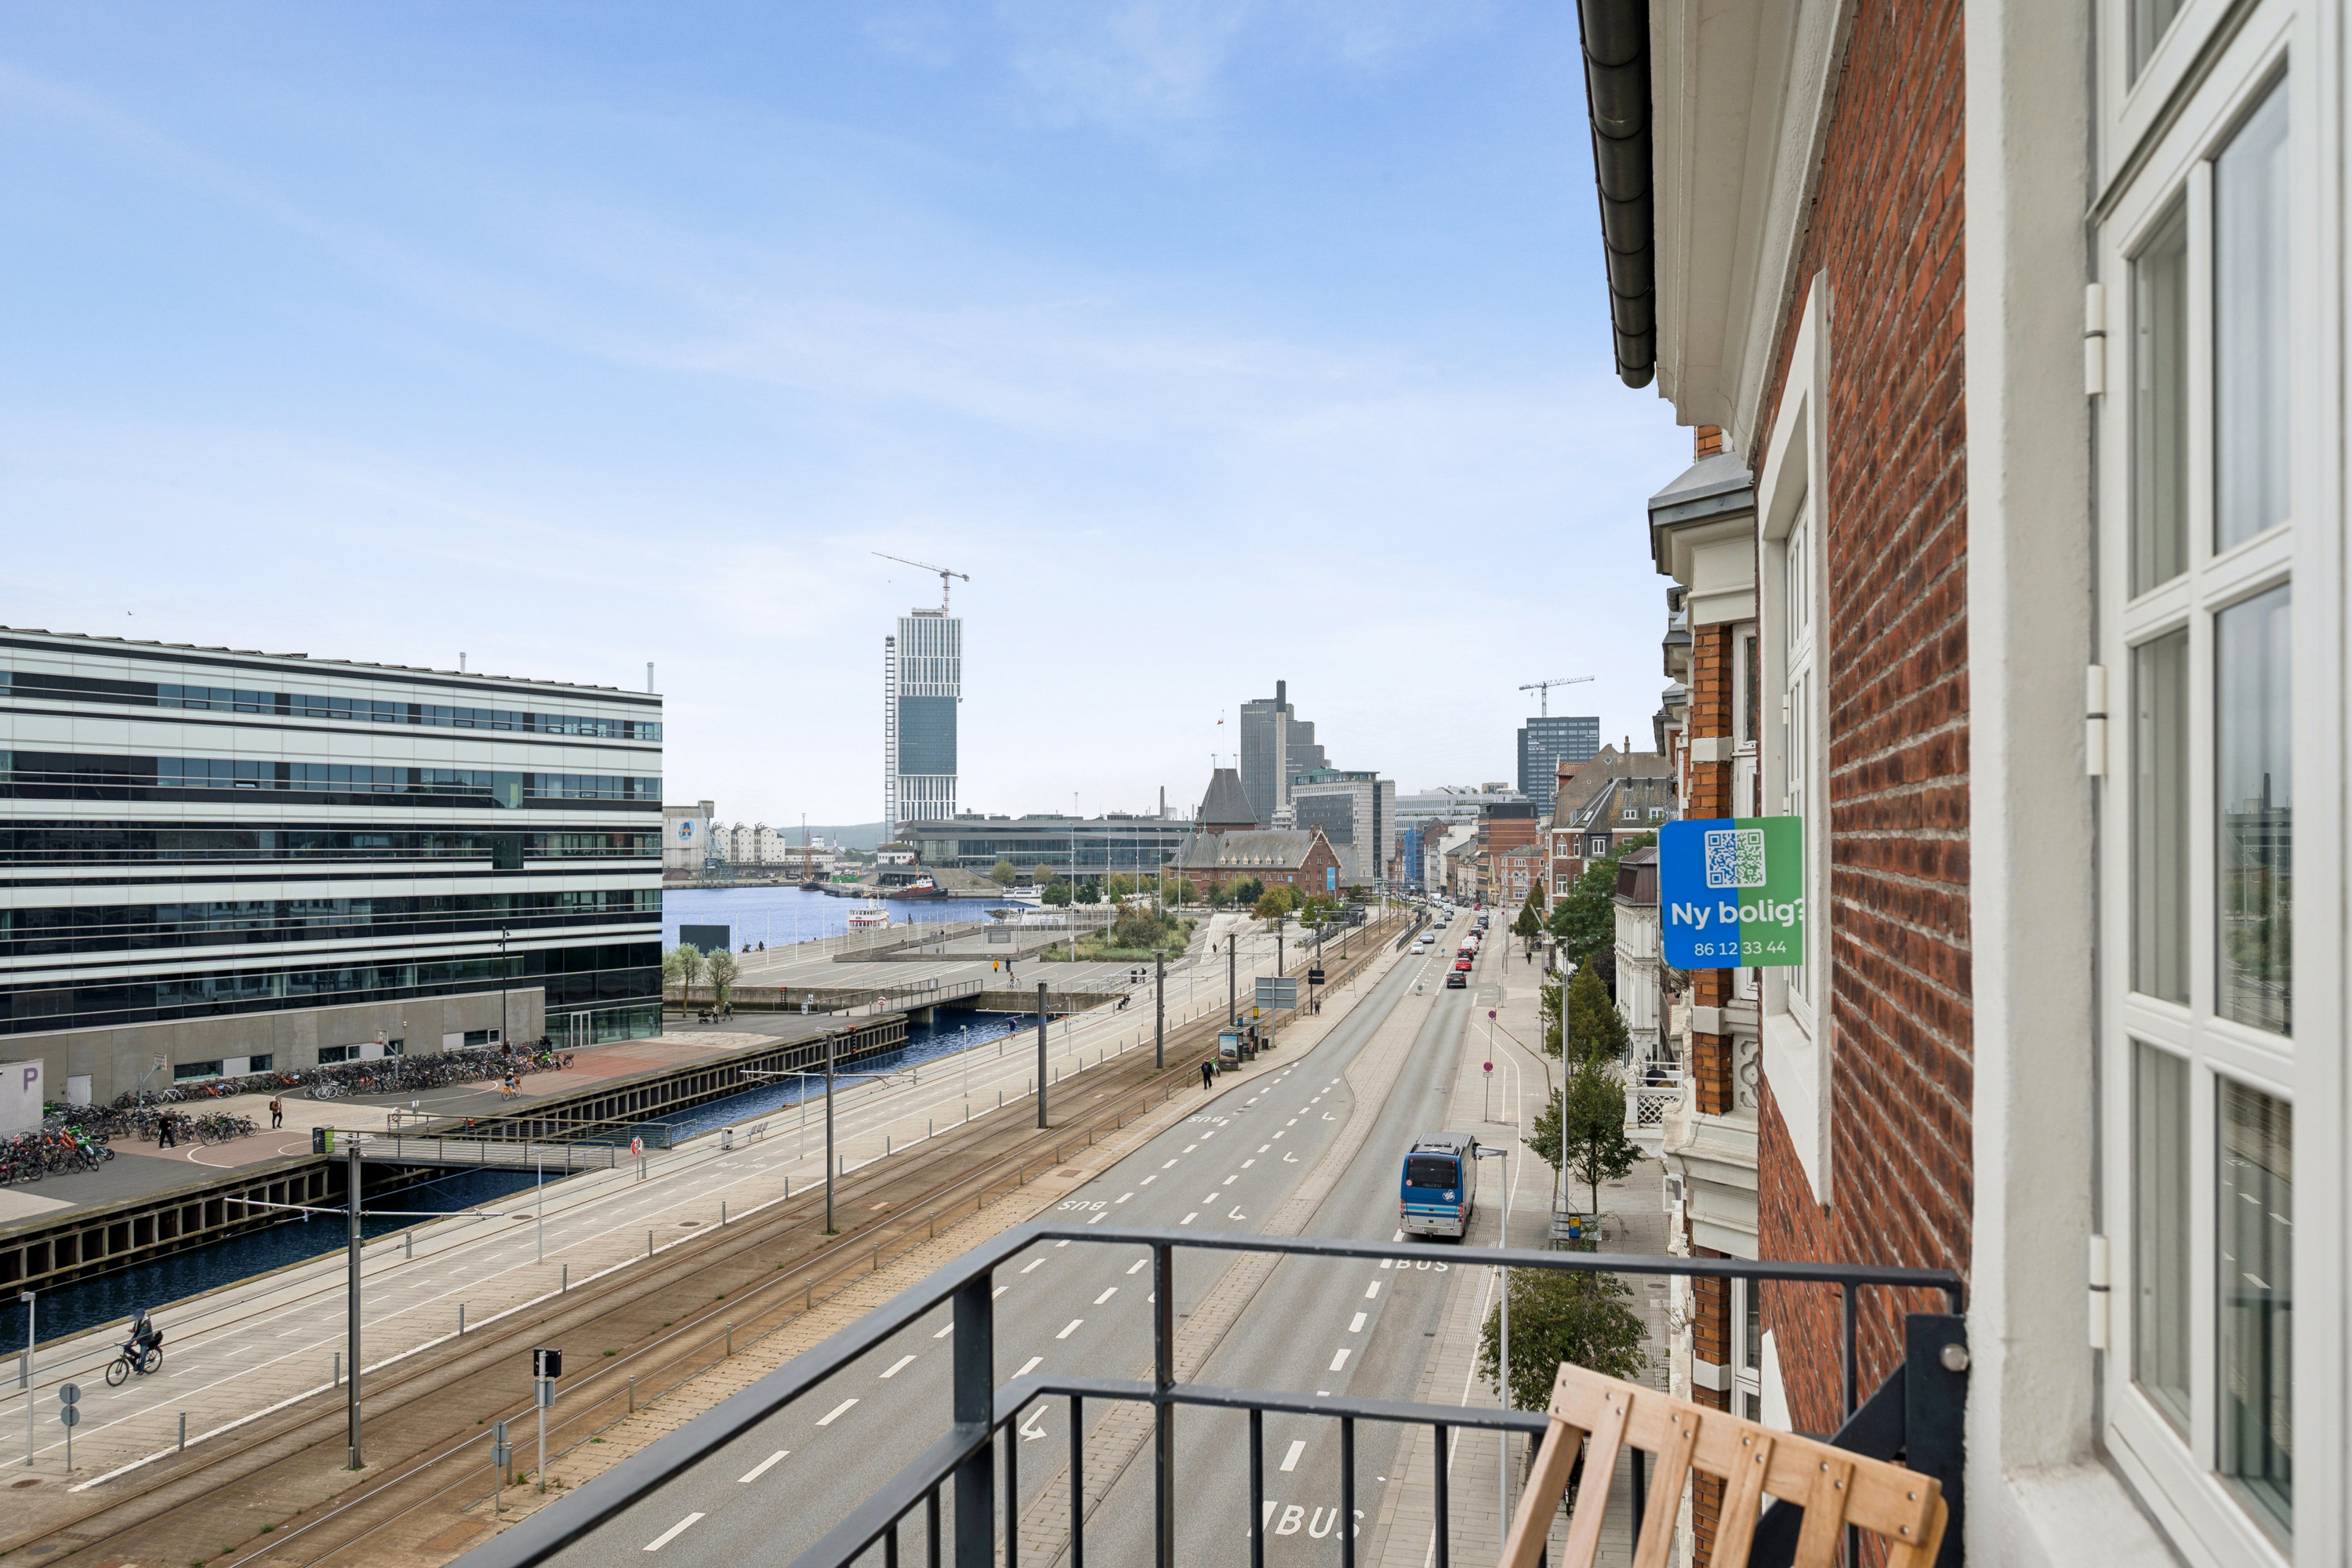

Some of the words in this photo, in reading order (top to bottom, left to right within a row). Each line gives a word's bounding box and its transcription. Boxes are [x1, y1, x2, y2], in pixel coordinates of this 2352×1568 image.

[1671, 902, 1711, 931] Ny
[1694, 942, 1715, 956] 86
[1719, 942, 1739, 956] 12
[1742, 941, 1762, 955] 33
[1766, 940, 1788, 953] 44
[24, 1067, 38, 1091] P
[1057, 1200, 1108, 1211] BUS
[1396, 1259, 1449, 1272] BUS
[1275, 1504, 1365, 1541] BUS
